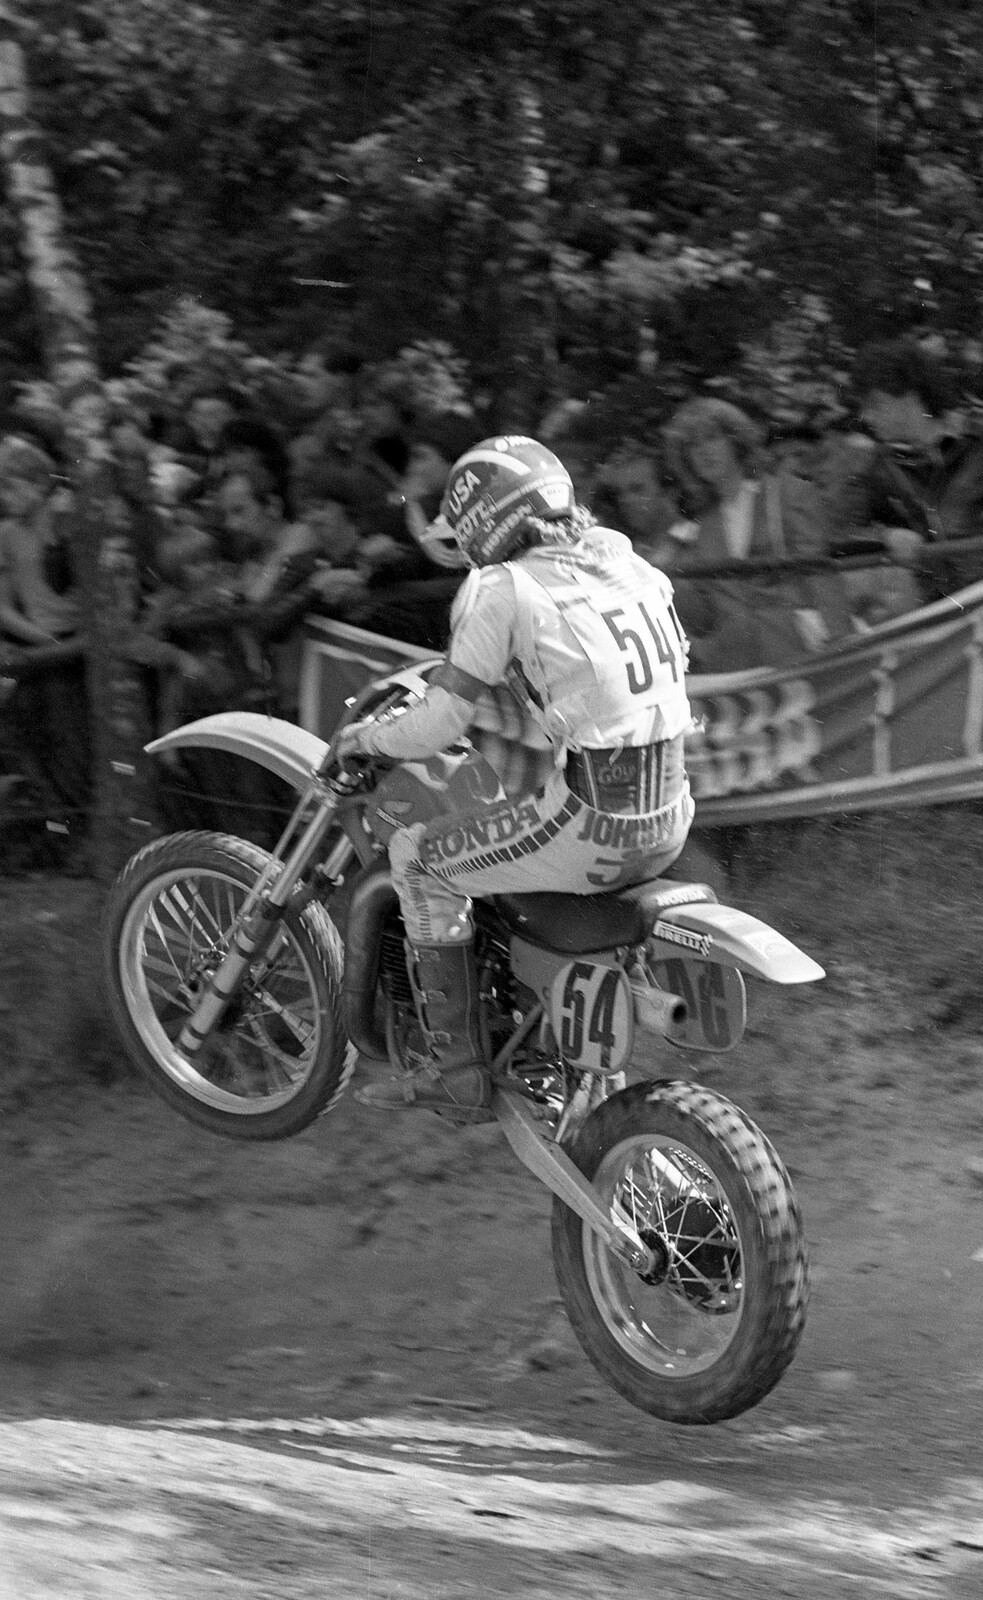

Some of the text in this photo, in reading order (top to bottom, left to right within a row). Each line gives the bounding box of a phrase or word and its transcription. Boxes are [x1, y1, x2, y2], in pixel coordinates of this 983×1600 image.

[449, 469, 482, 517] USA
[601, 601, 678, 695] 54
[419, 802, 542, 865] HONDA
[652, 919, 703, 951] PIRELLI
[561, 961, 621, 1070] 54
